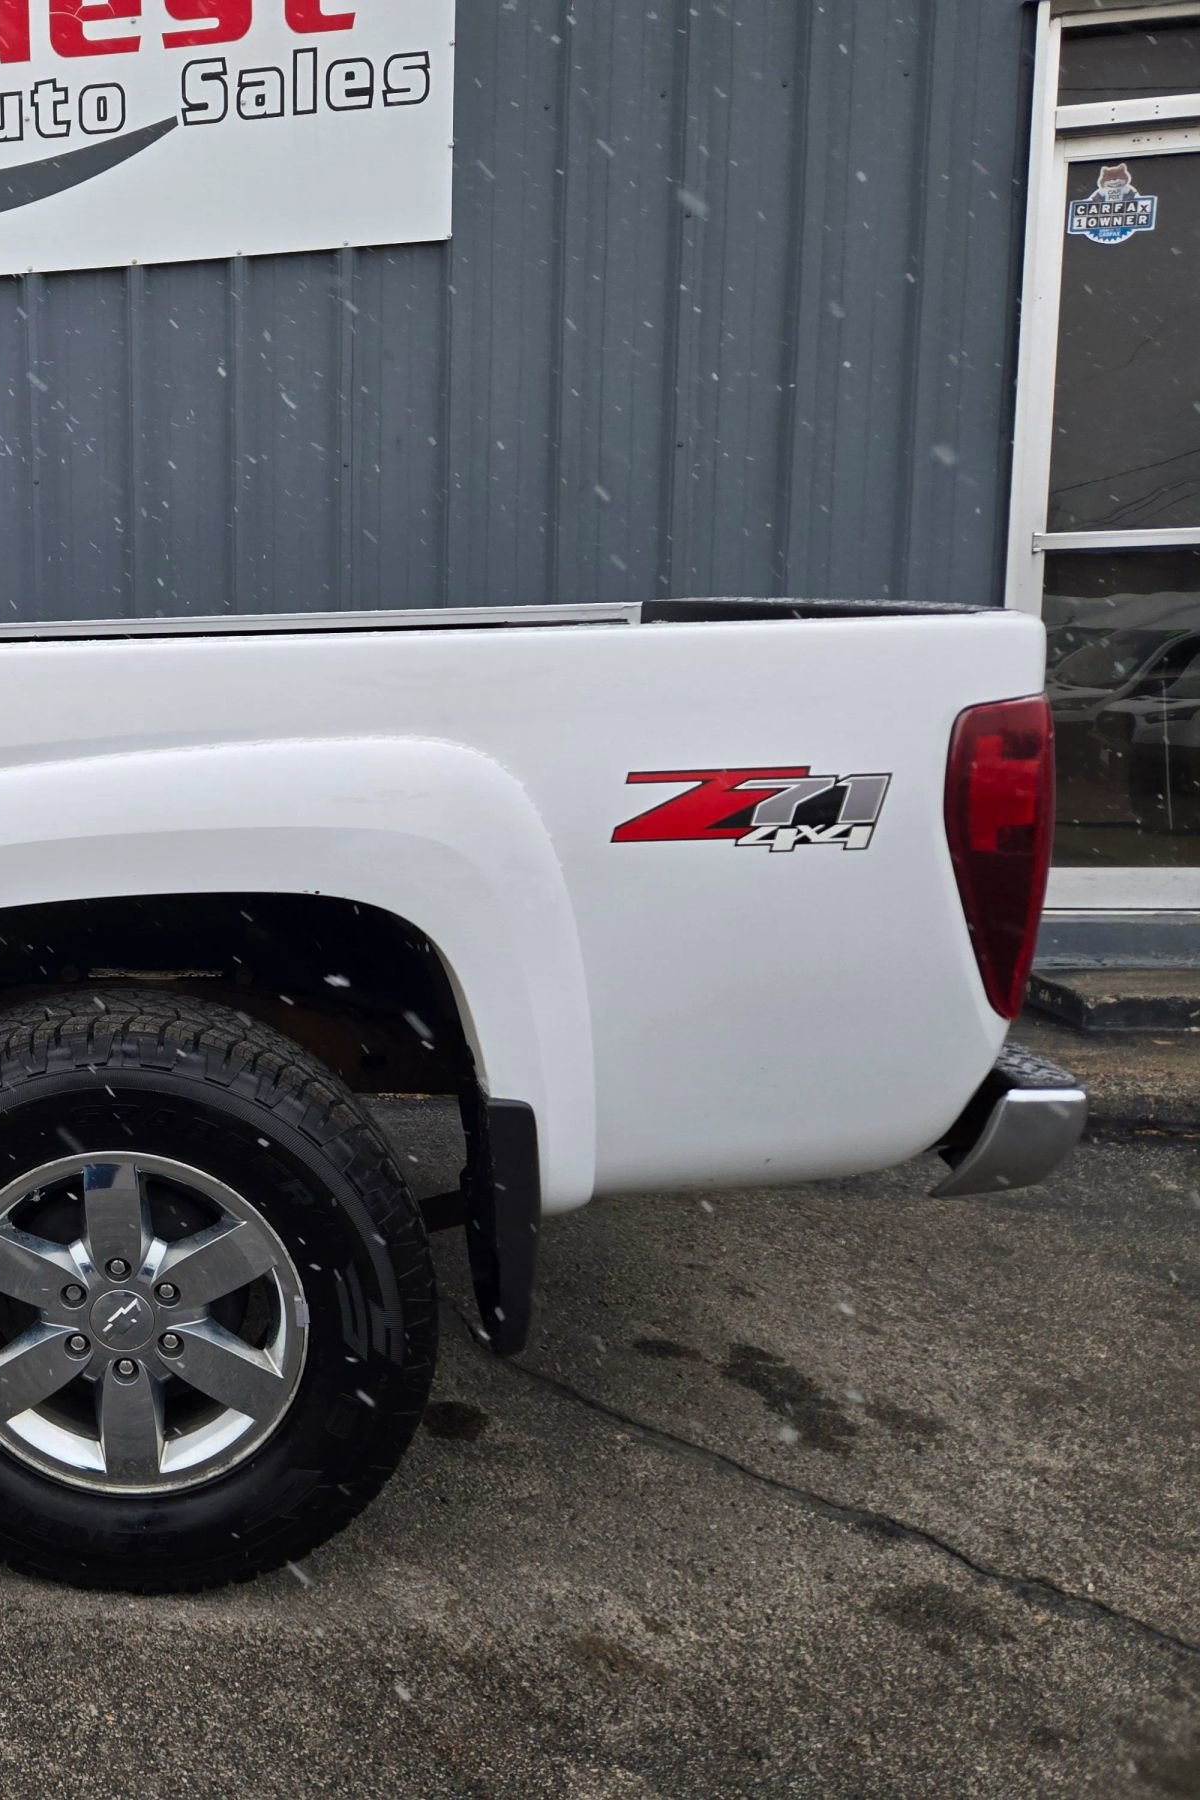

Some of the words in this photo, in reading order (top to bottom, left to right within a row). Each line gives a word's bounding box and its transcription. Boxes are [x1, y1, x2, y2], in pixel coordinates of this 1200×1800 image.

[181, 47, 431, 126] Sales
[1076, 202, 1150, 215] CARFAX
[610, 765, 893, 844] Z71
